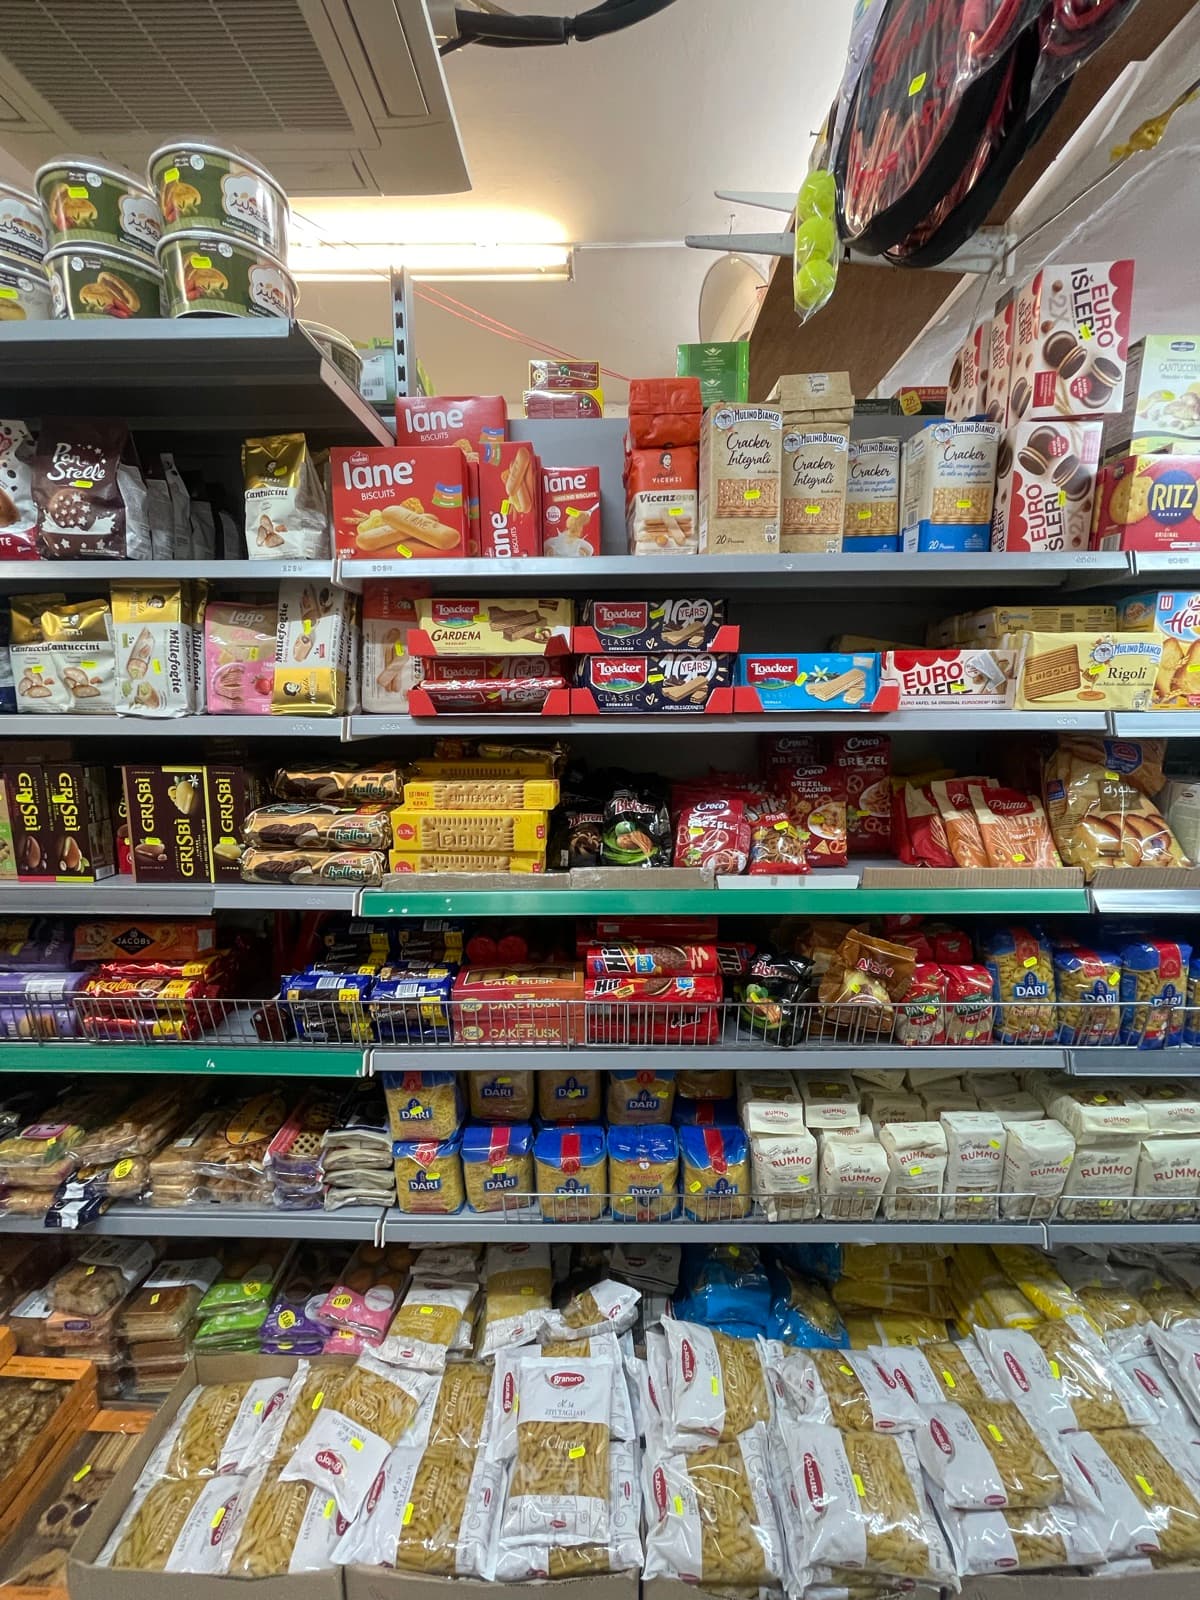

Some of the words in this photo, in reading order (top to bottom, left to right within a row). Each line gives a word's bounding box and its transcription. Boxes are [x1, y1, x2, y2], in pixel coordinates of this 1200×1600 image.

[1092, 284, 1113, 347] EURO
[405, 408, 464, 434] lane
[734, 409, 757, 422] MULINO
[757, 409, 780, 423] BIANCO
[952, 423, 975, 435] MULINO
[975, 423, 996, 435] BIANCO
[420, 432, 449, 442] BISCUITS
[726, 432, 772, 450] Cracker
[800, 433, 823, 444] MULINO
[823, 433, 844, 446] BIANCO
[859, 442, 878, 454] MULINO
[878, 442, 898, 453] BIANCO
[943, 445, 986, 461] Cracker
[53, 443, 83, 466] Pan
[727, 451, 772, 470] Integrali
[792, 454, 835, 471] Cracker
[46, 461, 106, 481] Stelle
[342, 461, 413, 490] lane
[851, 462, 891, 479] Cracker
[543, 474, 586, 494] lane
[652, 477, 682, 485] VICENZI
[793, 472, 834, 489] Integrali
[244, 488, 289, 501] Cantuccini
[361, 489, 396, 501] BISCUITS
[1151, 483, 1196, 511] RITZ
[1025, 484, 1047, 542] EURO
[491, 513, 514, 558] ane
[511, 526, 520, 554] BISCUITS
[716, 536, 727, 545] 20
[928, 540, 939, 549] 20
[435, 604, 476, 616] Loacker
[600, 606, 643, 620] Loacker
[679, 607, 706, 618] YEARS
[229, 609, 266, 629] Lago
[275, 602, 289, 663] Millefoglie
[431, 629, 481, 642] GARDENA
[48, 642, 100, 651] Cantuccini
[600, 638, 642, 646] CLASSIC
[1113, 643, 1138, 655] MULINO
[1138, 645, 1162, 656] BIANCO
[168, 628, 182, 694] Millefoglie
[681, 661, 709, 672] YEARS
[438, 666, 481, 678] Loacker
[596, 662, 642, 676] Loacker
[751, 663, 793, 675] Loacker
[1108, 667, 1147, 682] Rigoli
[903, 661, 964, 690] EURO
[597, 694, 641, 702] CLASSIC
[847, 737, 879, 749] Croco
[838, 756, 888, 767] BREZEL
[796, 767, 824, 778] Croco
[351, 784, 386, 797] halley
[695, 800, 728, 812] Croco
[988, 798, 1028, 810] Prima
[335, 829, 372, 843] halley
[437, 831, 498, 849] LEIBNIZ
[328, 865, 366, 880] halley
[519, 977, 554, 987] RUSK
[1016, 986, 1046, 997] DARI
[489, 1028, 524, 1039] CAKE
[527, 1028, 561, 1039] RUSK
[484, 1088, 512, 1097] DARI
[629, 1100, 657, 1109] DARI
[402, 1109, 430, 1119] DARI
[765, 1110, 790, 1118] RUMMO
[822, 1108, 848, 1116] RUMMO
[772, 1156, 812, 1168] RUMMO
[900, 1151, 937, 1166] RUMMO
[961, 1150, 1000, 1162] RUMMO
[1030, 1167, 1068, 1177] RUMMO
[1081, 1166, 1133, 1179] RUMMO
[410, 1180, 439, 1190] DARI
[486, 1178, 515, 1190] DARI
[840, 1175, 882, 1184] RUMMO
[333, 1297, 351, 1306] £1.00
[553, 1375, 583, 1385] granoro
